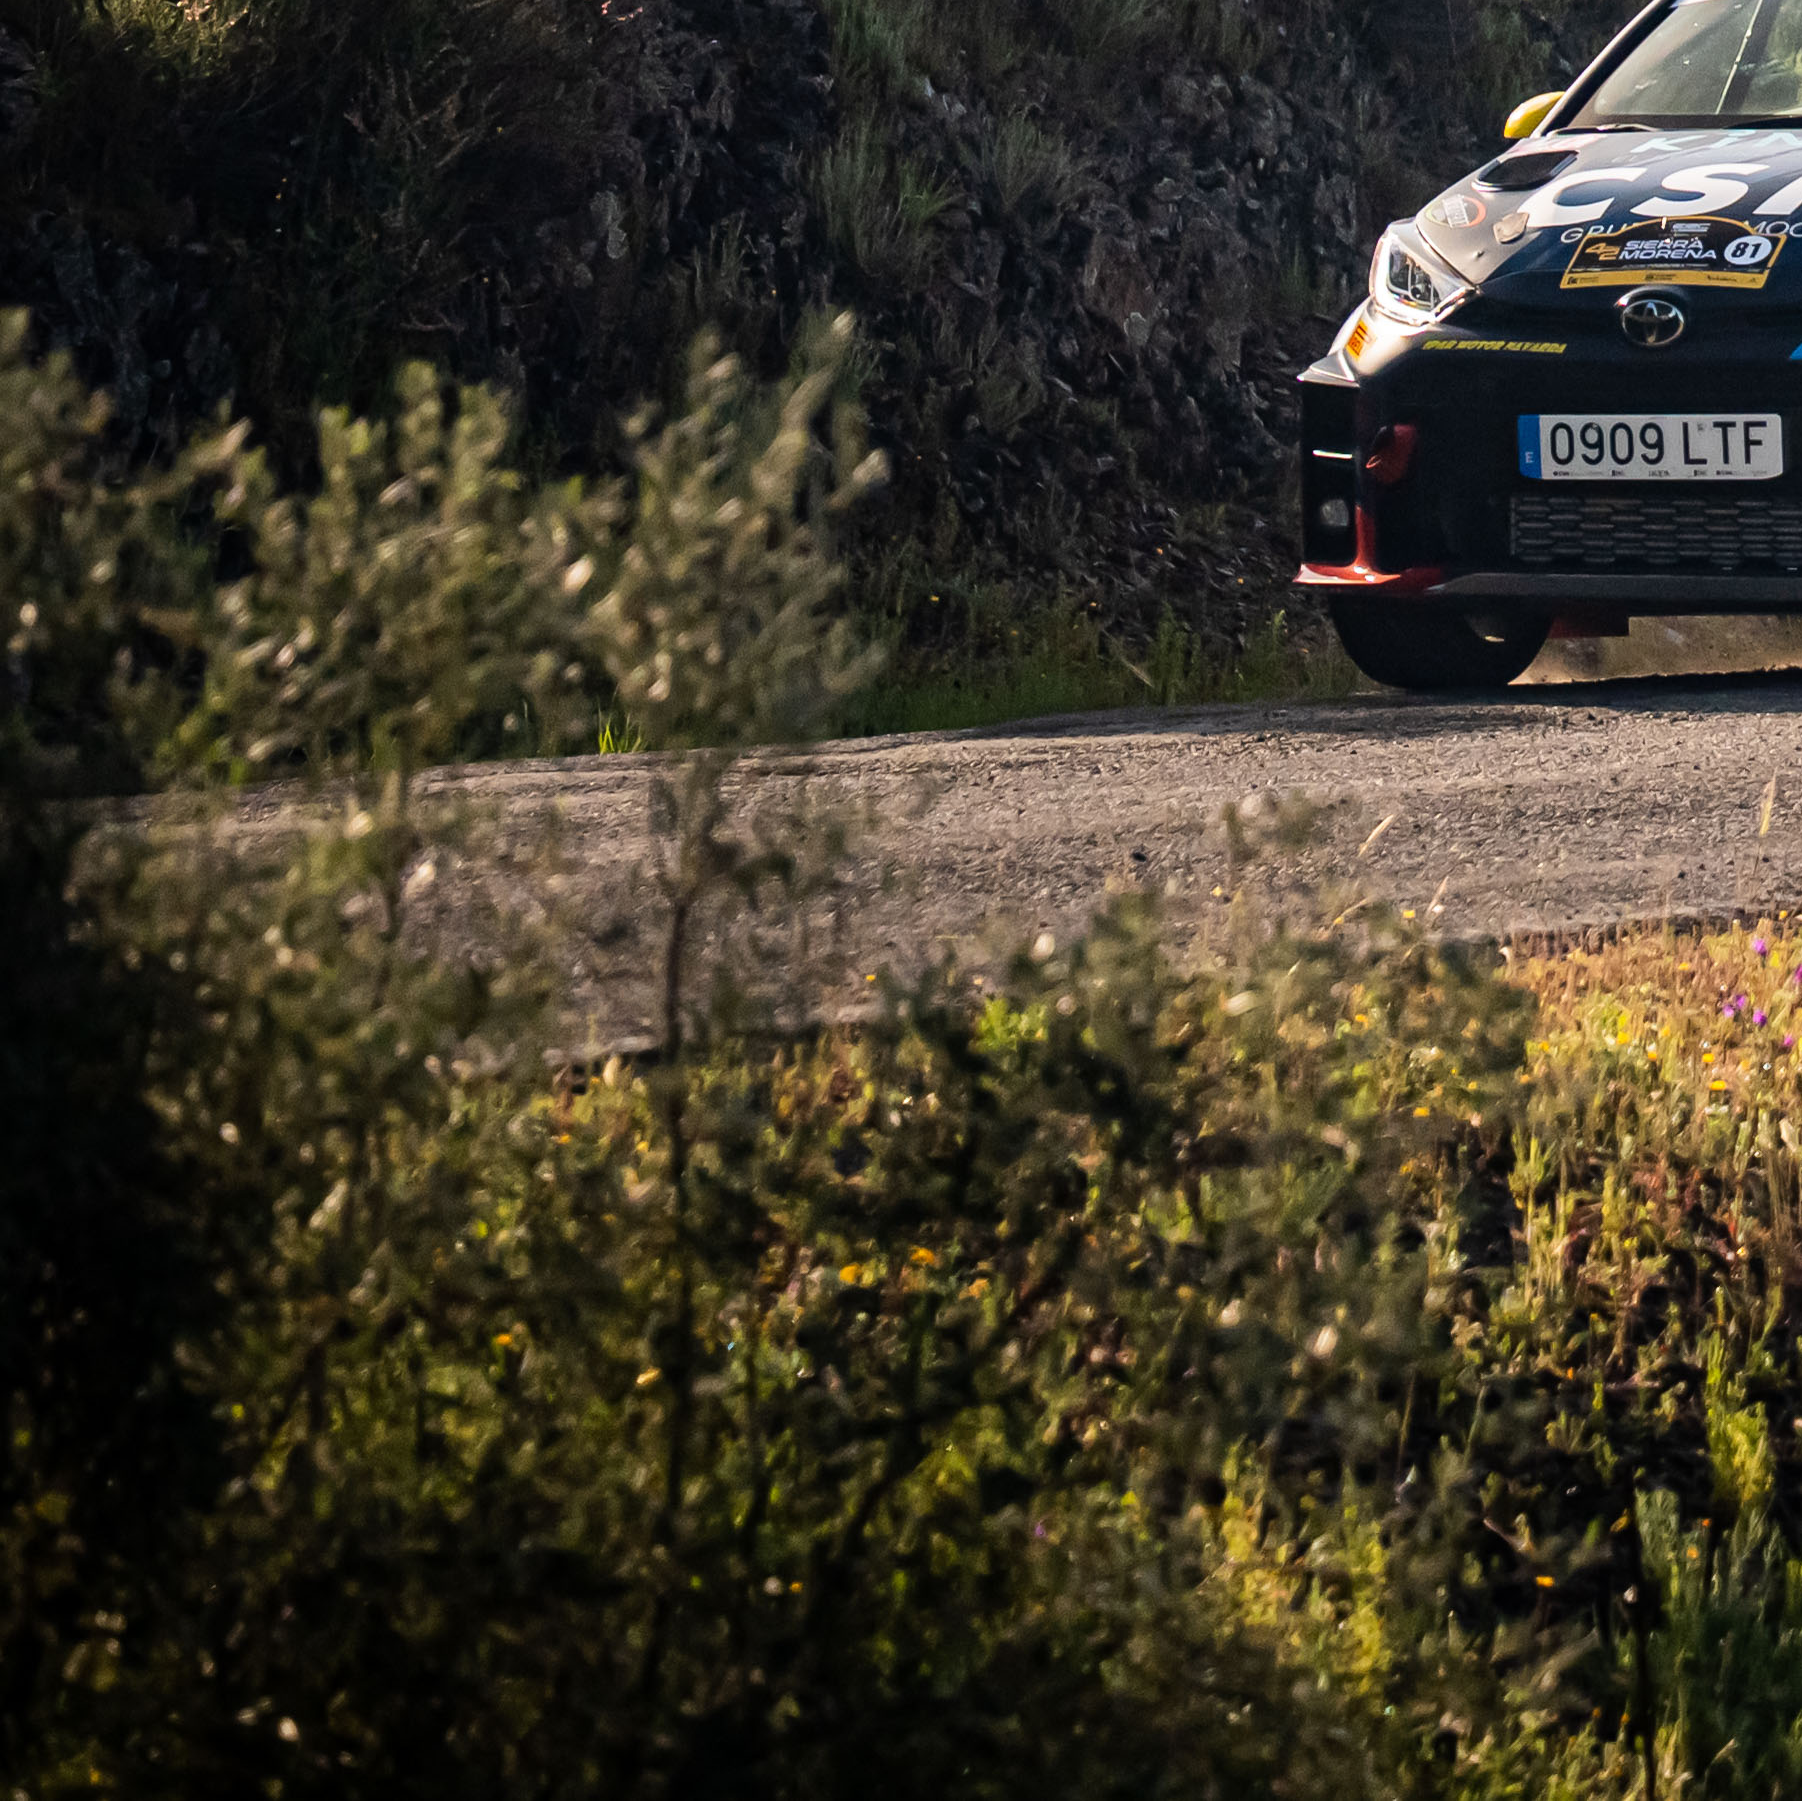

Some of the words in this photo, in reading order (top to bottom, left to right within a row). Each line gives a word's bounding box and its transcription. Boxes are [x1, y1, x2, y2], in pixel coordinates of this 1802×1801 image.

[1585, 242, 1620, 260] 42
[1624, 239, 1704, 250] SIERRA
[1730, 241, 1763, 260] 81
[1619, 249, 1717, 260] MORENA
[1525, 451, 1534, 464] E
[1549, 421, 1665, 466] 0909
[1682, 420, 1768, 466] LTF
